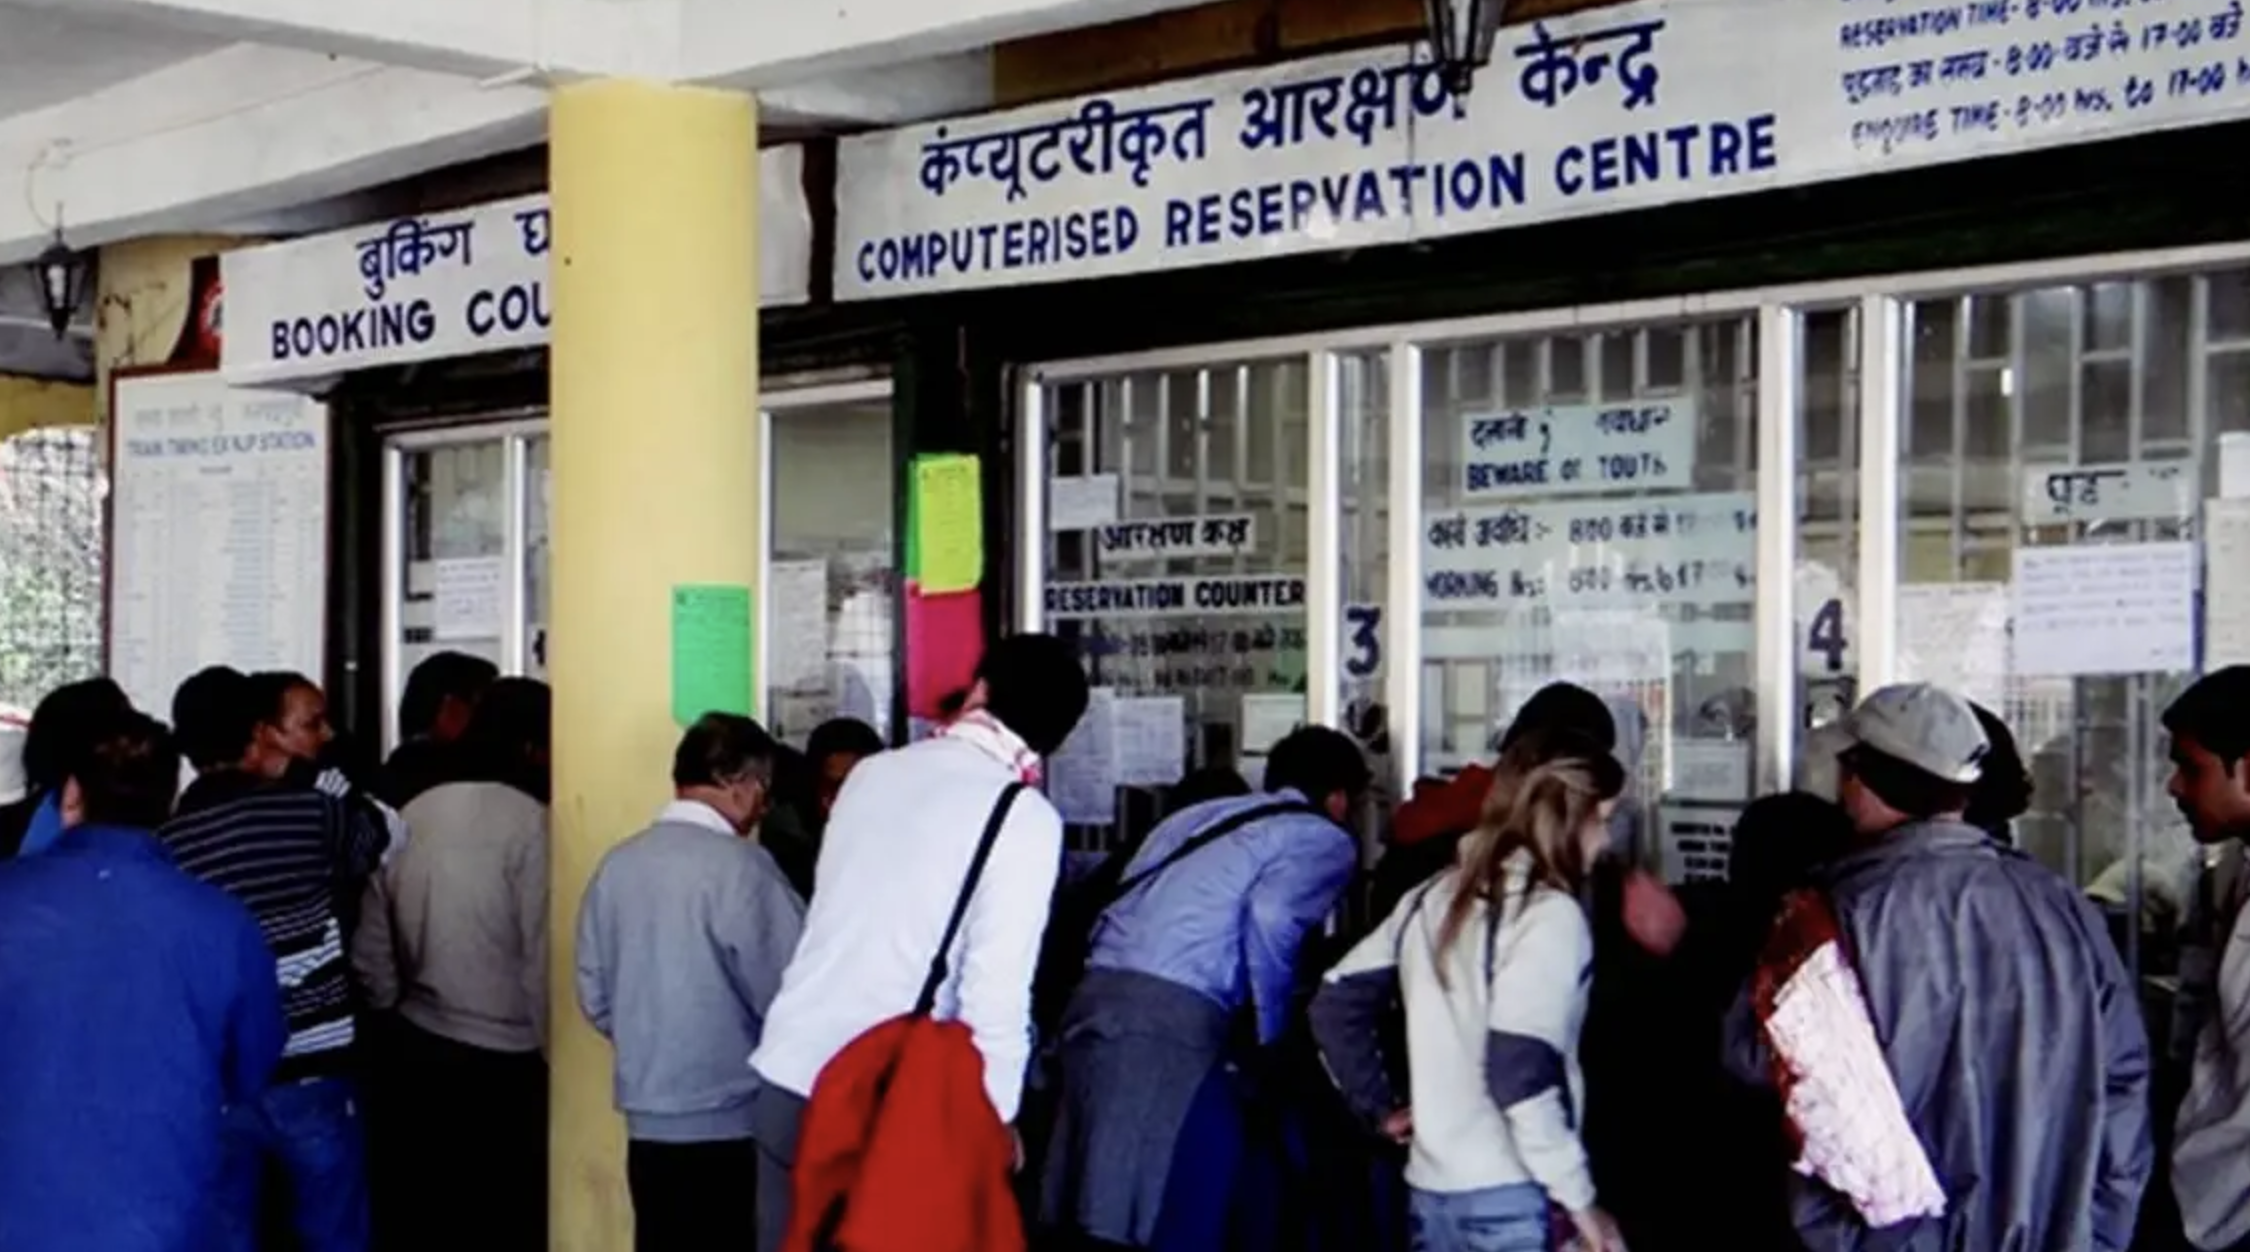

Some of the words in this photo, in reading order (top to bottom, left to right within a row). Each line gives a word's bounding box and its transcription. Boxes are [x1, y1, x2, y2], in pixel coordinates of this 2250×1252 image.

[920, 99, 1213, 200] कंप्यूटरीकृत
[1514, 20, 1665, 108] केन्द्र
[857, 206, 1140, 283] COMPUTERISED
[1165, 153, 1525, 249] RESERVATION
[1555, 115, 1777, 196] CENTRE
[357, 215, 475, 299] बुकिंग
[514, 208, 551, 257] घ
[271, 300, 436, 360] BOOKING
[466, 280, 551, 336] COU
[1466, 460, 1549, 492] BEWARE
[1044, 582, 1185, 612] RESERVATION
[1195, 578, 1306, 608] COUNTER
[1346, 606, 1381, 677] 3
[1808, 597, 1848, 671] 4
